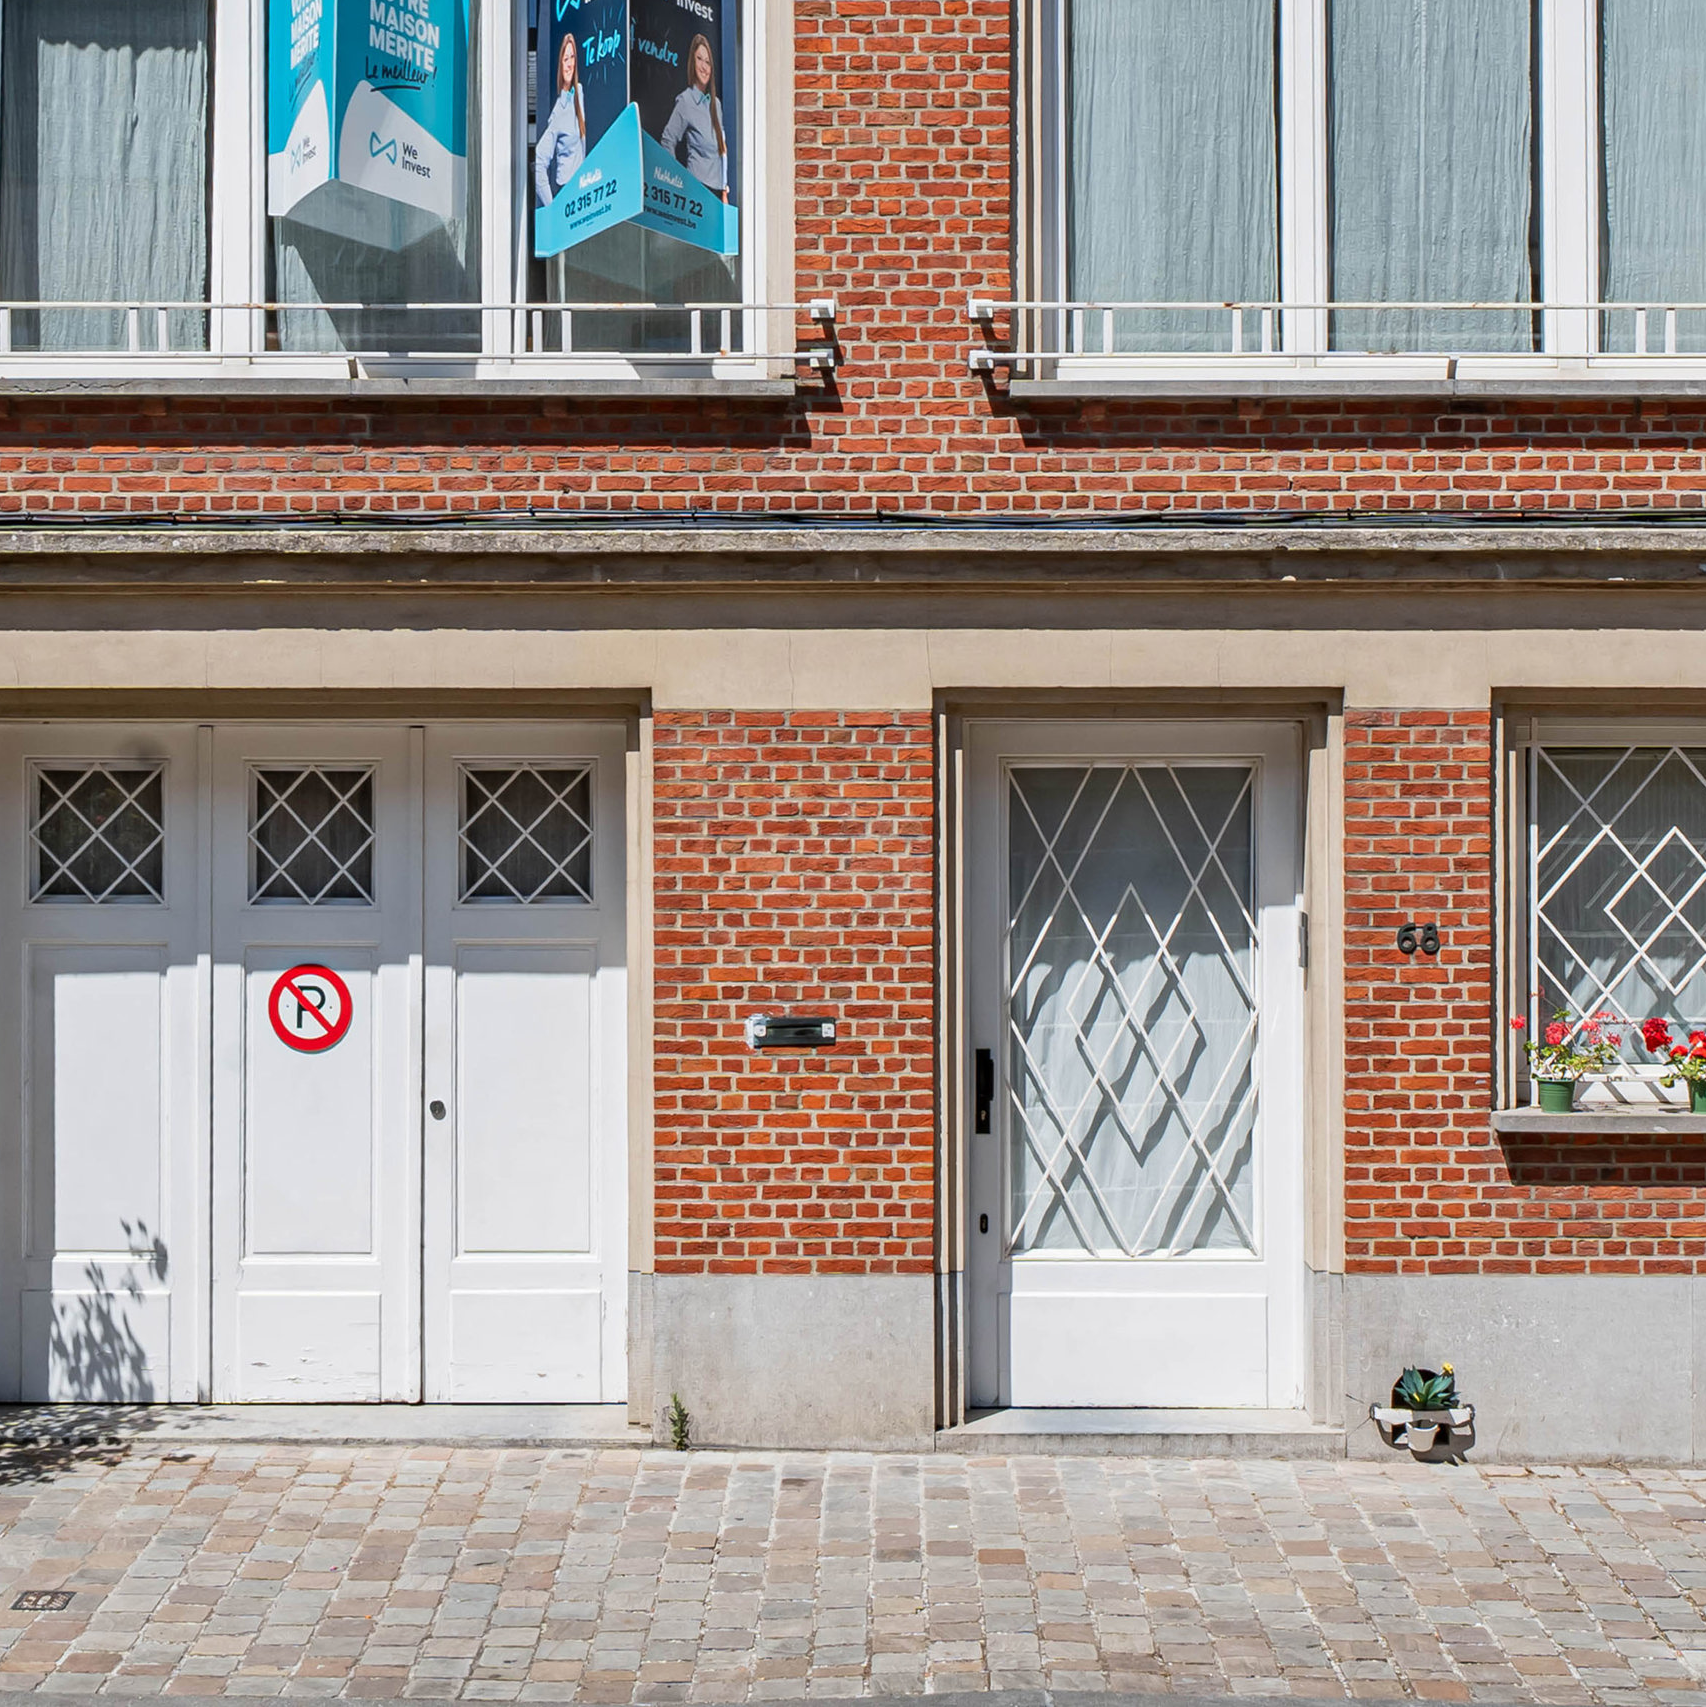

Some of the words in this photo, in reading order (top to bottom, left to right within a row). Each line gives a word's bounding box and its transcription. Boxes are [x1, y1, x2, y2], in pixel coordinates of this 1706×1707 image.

[369, 24, 435, 73] MÉRITE
[582, 36, 595, 67] Te
[596, 29, 621, 62] koop
[638, 37, 679, 67] vendre
[365, 55, 378, 79] Le
[402, 141, 418, 159] We
[402, 157, 431, 178] Invest
[564, 200, 576, 218] 02
[577, 191, 591, 211] 315
[593, 185, 604, 203] 77
[605, 179, 617, 198] 22
[651, 185, 671, 206] 315
[673, 193, 687, 211] 77
[689, 199, 703, 218] 22
[1397, 922, 1441, 955] 68
